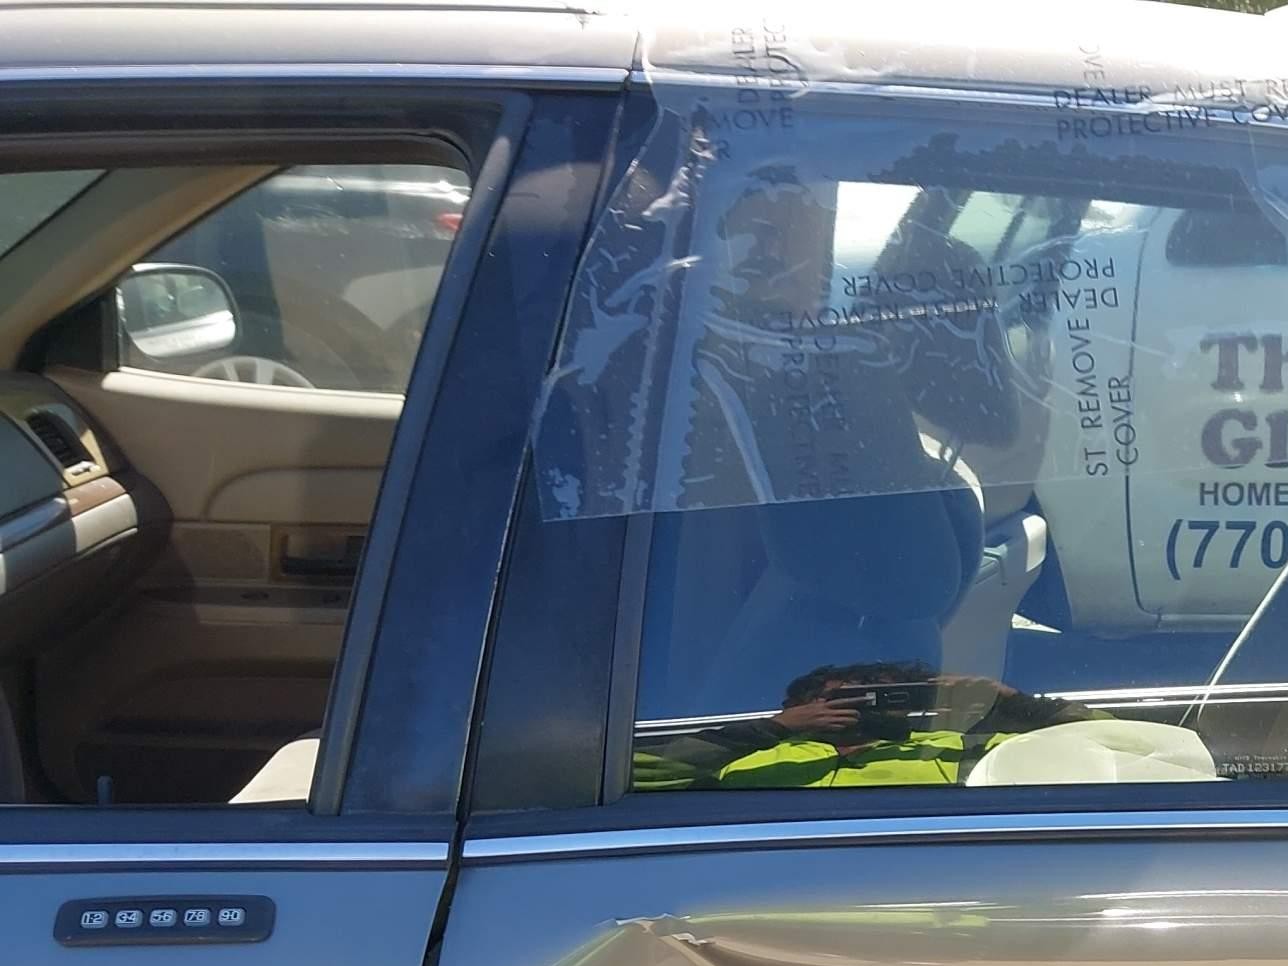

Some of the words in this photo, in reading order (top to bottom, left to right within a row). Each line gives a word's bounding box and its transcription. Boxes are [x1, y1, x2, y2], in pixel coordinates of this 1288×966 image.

[1053, 84, 1152, 108] DEALER
[1174, 79, 1248, 100] MUST
[1056, 102, 1219, 140] PROTECTIVE
[842, 271, 936, 297] COVER
[951, 257, 1116, 291] PROTECTIVE
[1018, 286, 1119, 315] DEALER
[1068, 318, 1102, 430] REMOVE
[1109, 375, 1140, 466] COVER
